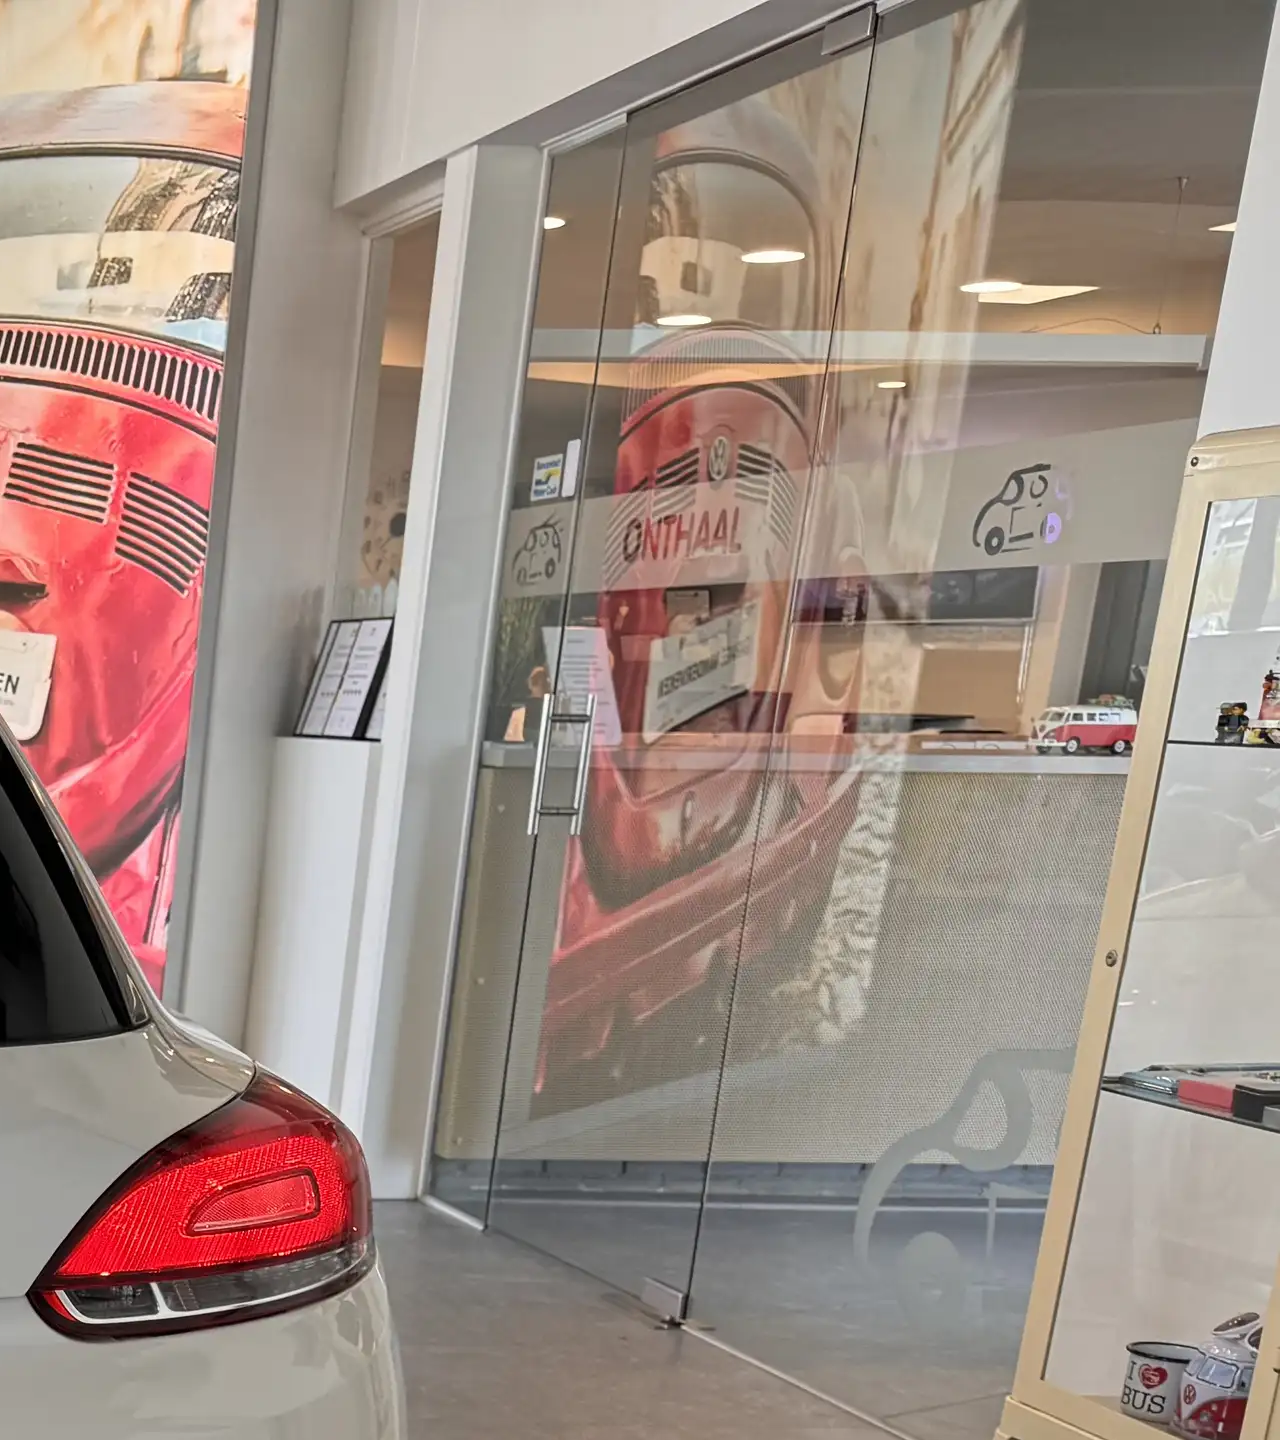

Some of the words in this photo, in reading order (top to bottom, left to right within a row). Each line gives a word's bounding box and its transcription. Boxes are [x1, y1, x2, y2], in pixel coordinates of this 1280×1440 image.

[622, 505, 742, 562] ONTHAAL
[1126, 1359, 1137, 1381] I
[1120, 1384, 1167, 1415] BUS
